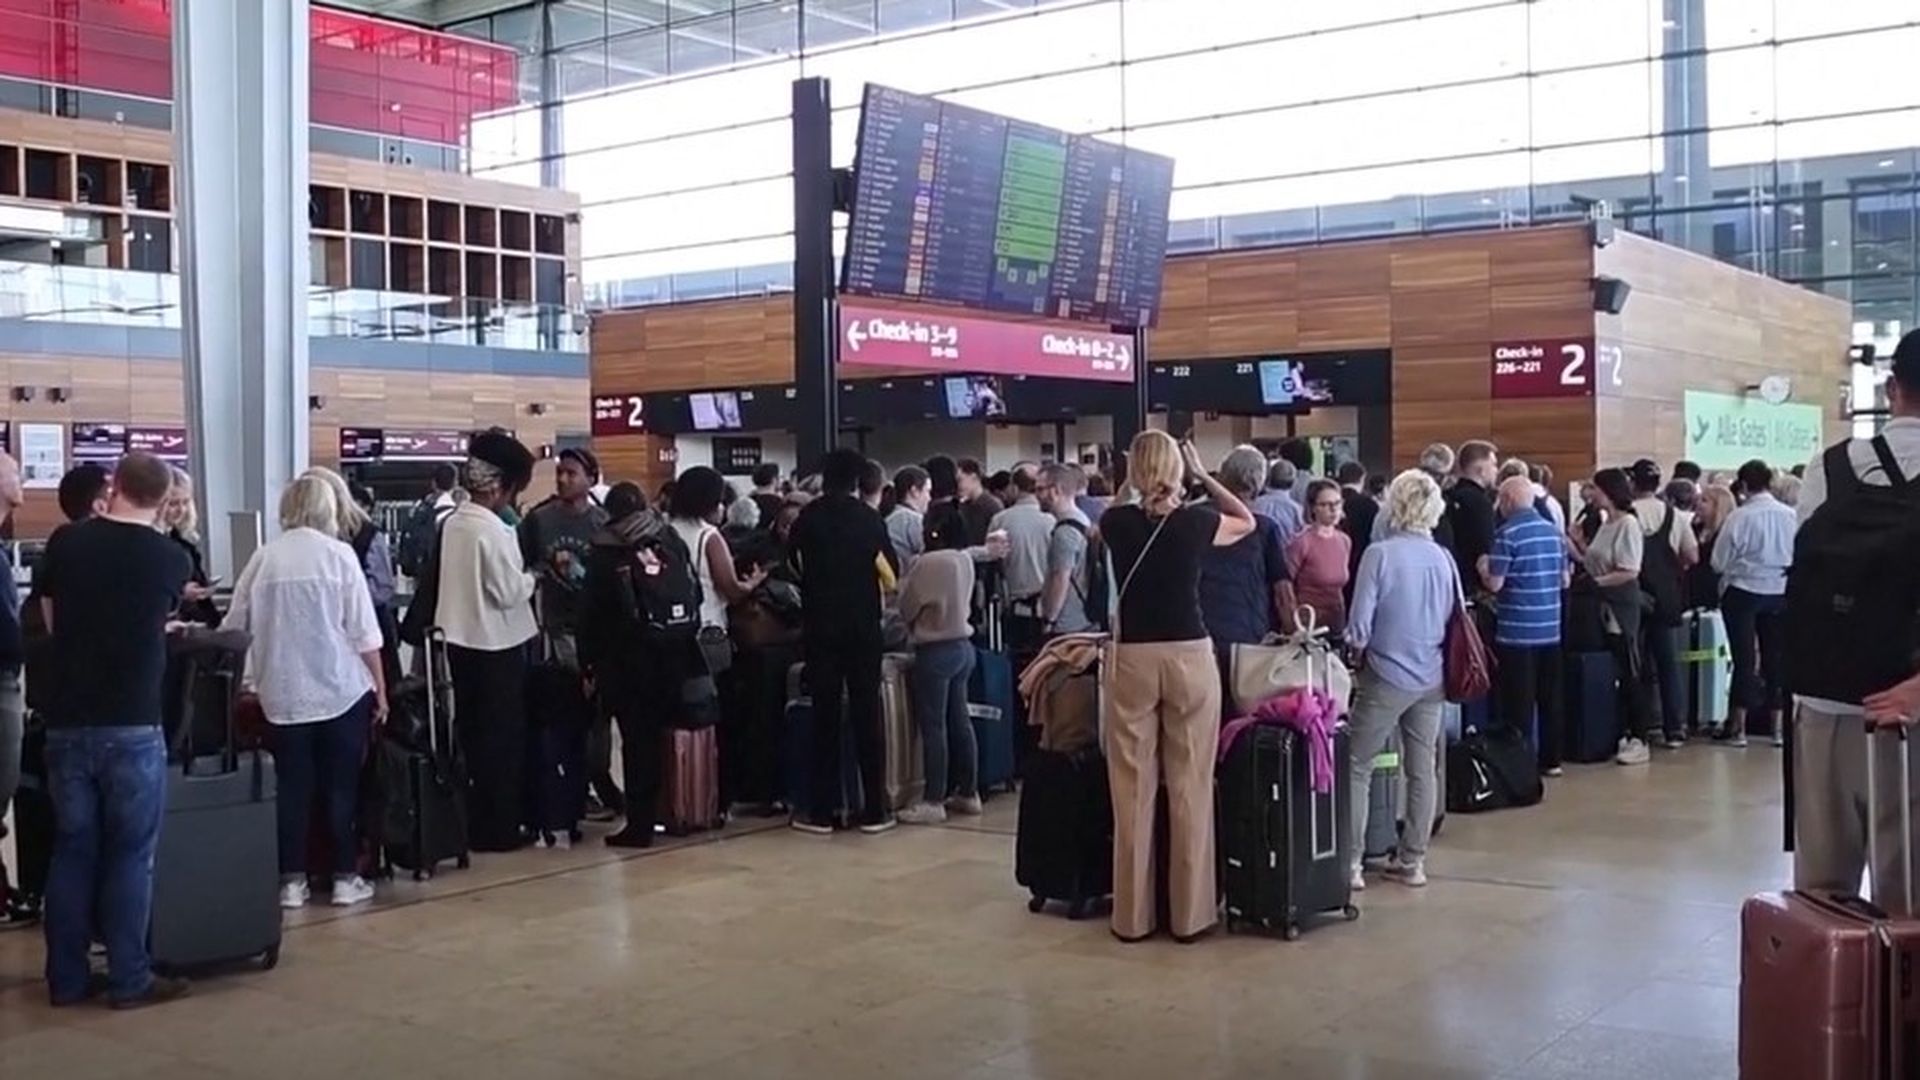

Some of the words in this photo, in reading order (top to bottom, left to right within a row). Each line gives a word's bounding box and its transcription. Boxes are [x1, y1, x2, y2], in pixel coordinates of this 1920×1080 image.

[869, 319, 929, 342] Check-in
[1042, 334, 1091, 356] Check-in
[1496, 346, 1543, 359] Check-in
[1172, 366, 1190, 377] 222
[1561, 344, 1586, 385] 2
[1612, 346, 1623, 386] 2
[628, 396, 644, 427] 2
